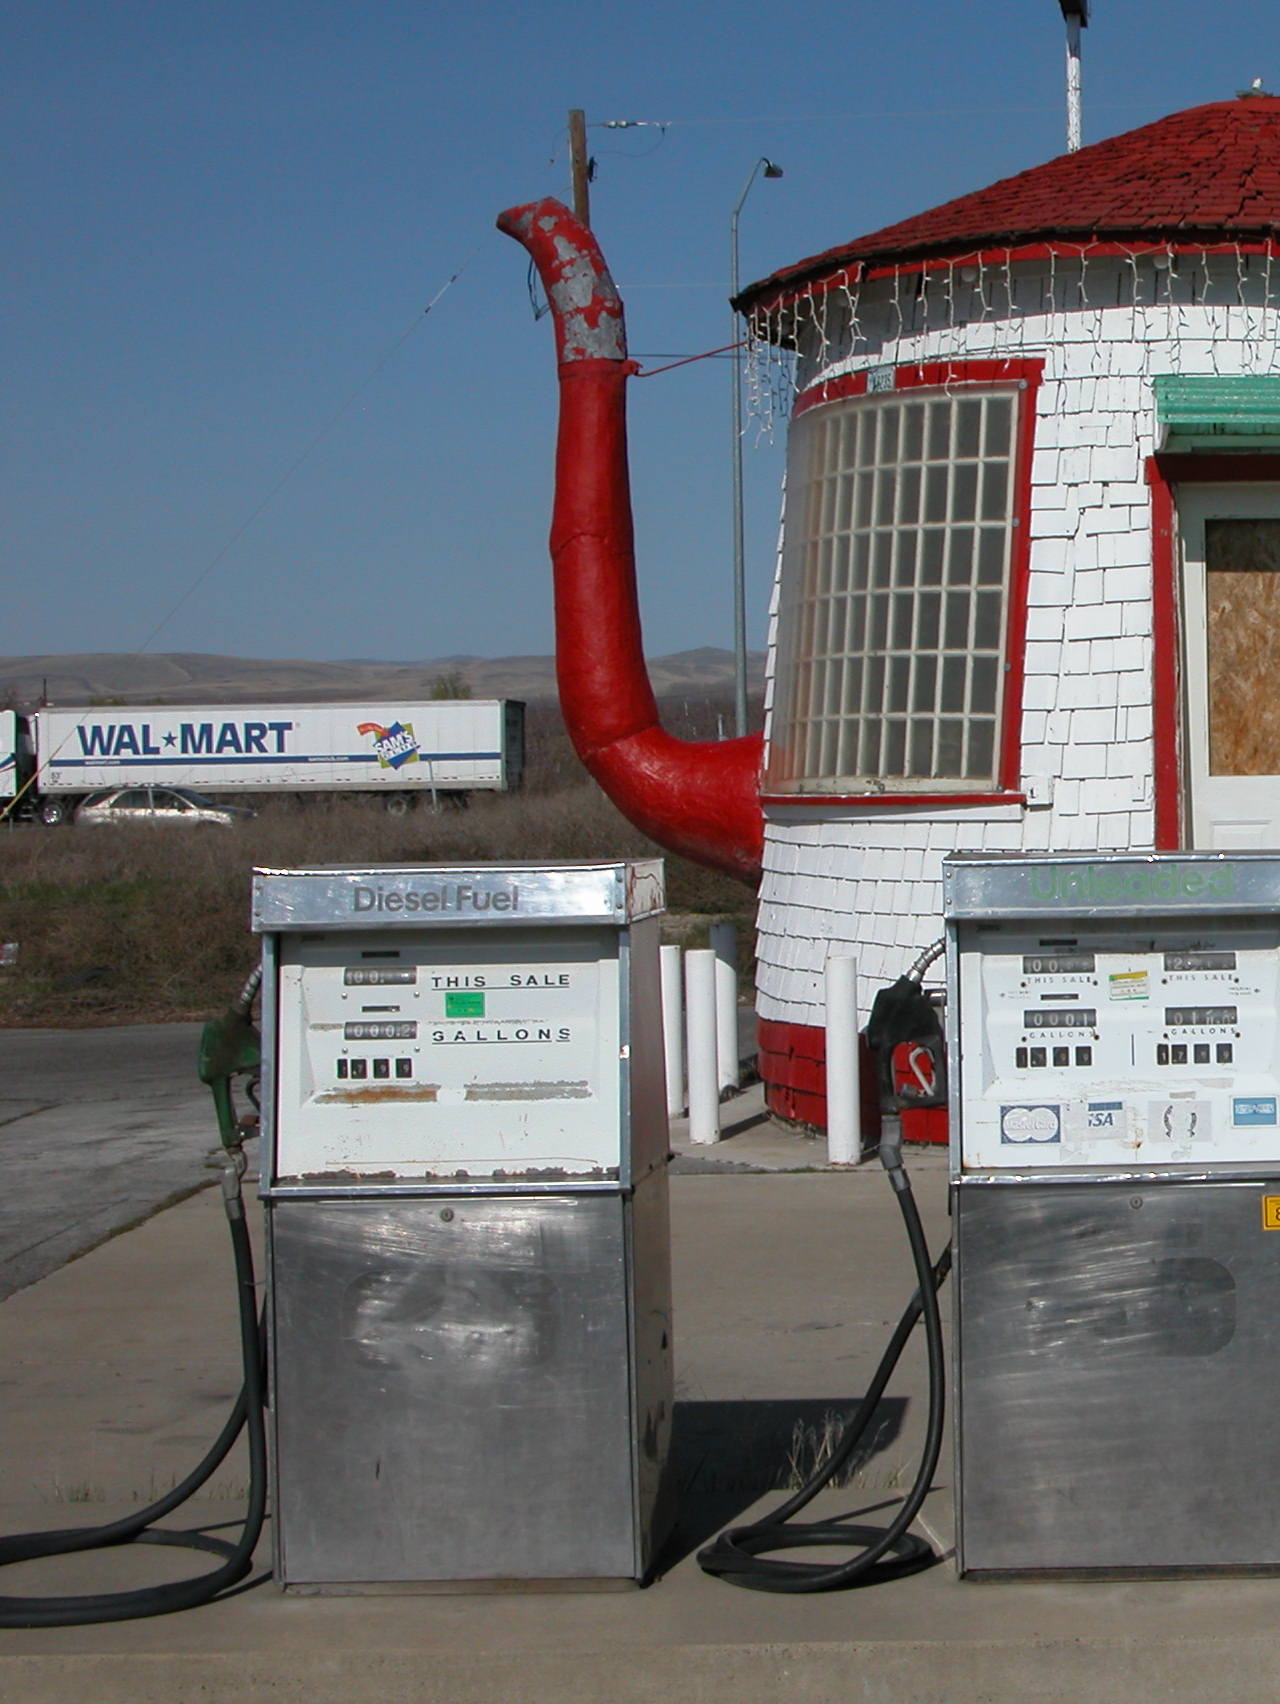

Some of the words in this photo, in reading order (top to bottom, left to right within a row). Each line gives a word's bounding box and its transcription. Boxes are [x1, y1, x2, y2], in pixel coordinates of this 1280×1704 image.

[1032, 864, 1234, 900] Unleaded
[352, 886, 448, 914] Diesel
[455, 885, 519, 912] Fuel
[432, 976, 486, 988] THIS
[510, 974, 571, 986] SALE
[1027, 976, 1054, 984] THIS
[432, 1028, 571, 1042] GALLONS
[1171, 1027, 1236, 1035] GALLONS
